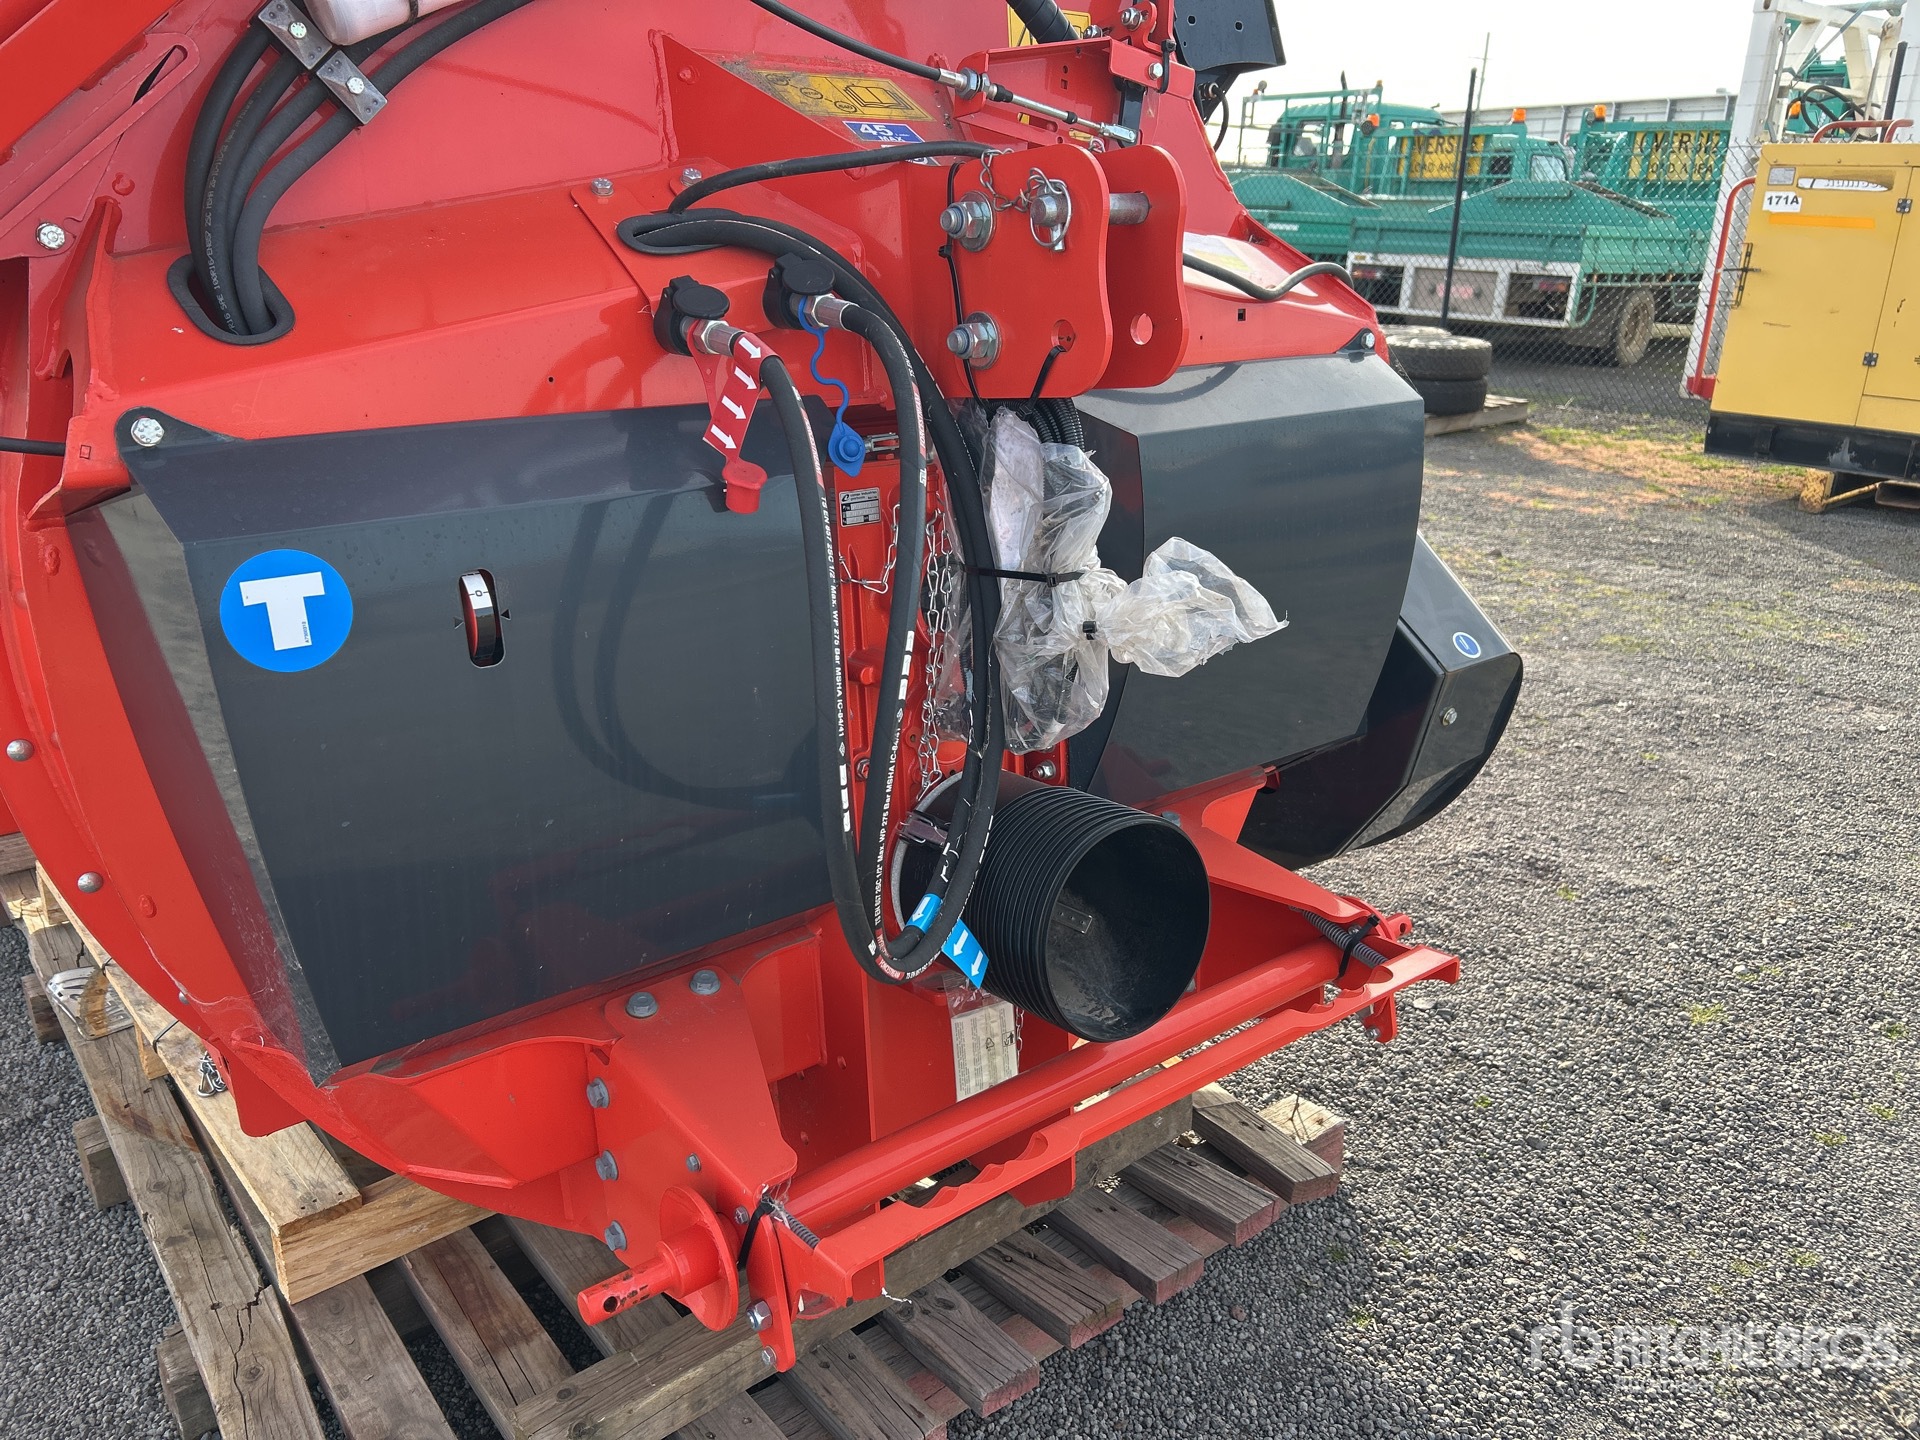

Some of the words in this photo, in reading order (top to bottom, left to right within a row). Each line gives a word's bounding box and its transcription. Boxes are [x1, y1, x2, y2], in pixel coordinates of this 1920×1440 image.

[860, 123, 894, 136] 45
[1767, 195, 1800, 206] 171A
[216, 293, 228, 310] SAE
[823, 511, 830, 524] EN
[827, 543, 835, 563] 2SC
[830, 585, 838, 608] Max.
[239, 571, 325, 651] T
[832, 610, 839, 627] WP
[835, 666, 843, 698] MSHA
[886, 764, 895, 793] MSHA
[883, 794, 891, 811] Bar
[879, 827, 887, 842] WP
